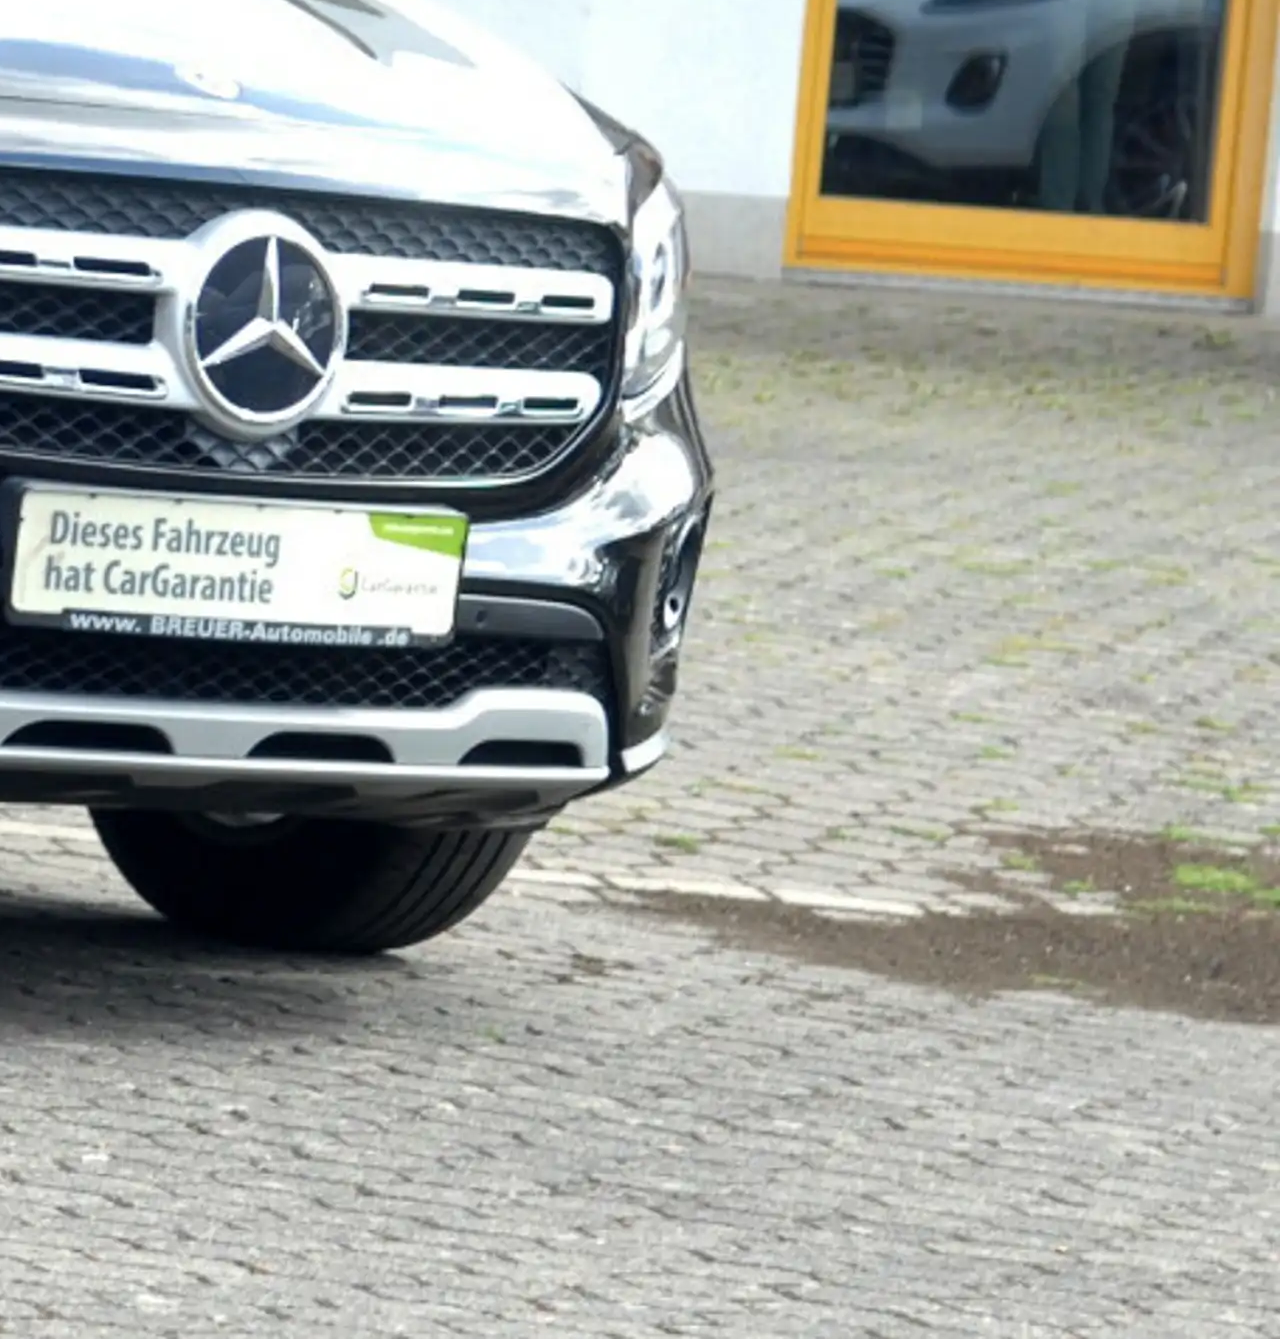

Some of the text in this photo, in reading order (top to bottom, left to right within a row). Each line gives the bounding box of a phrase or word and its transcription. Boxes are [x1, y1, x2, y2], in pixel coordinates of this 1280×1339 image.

[50, 510, 281, 568] Dieses Fahrzeug
[44, 555, 274, 604] hat CarGarantie
